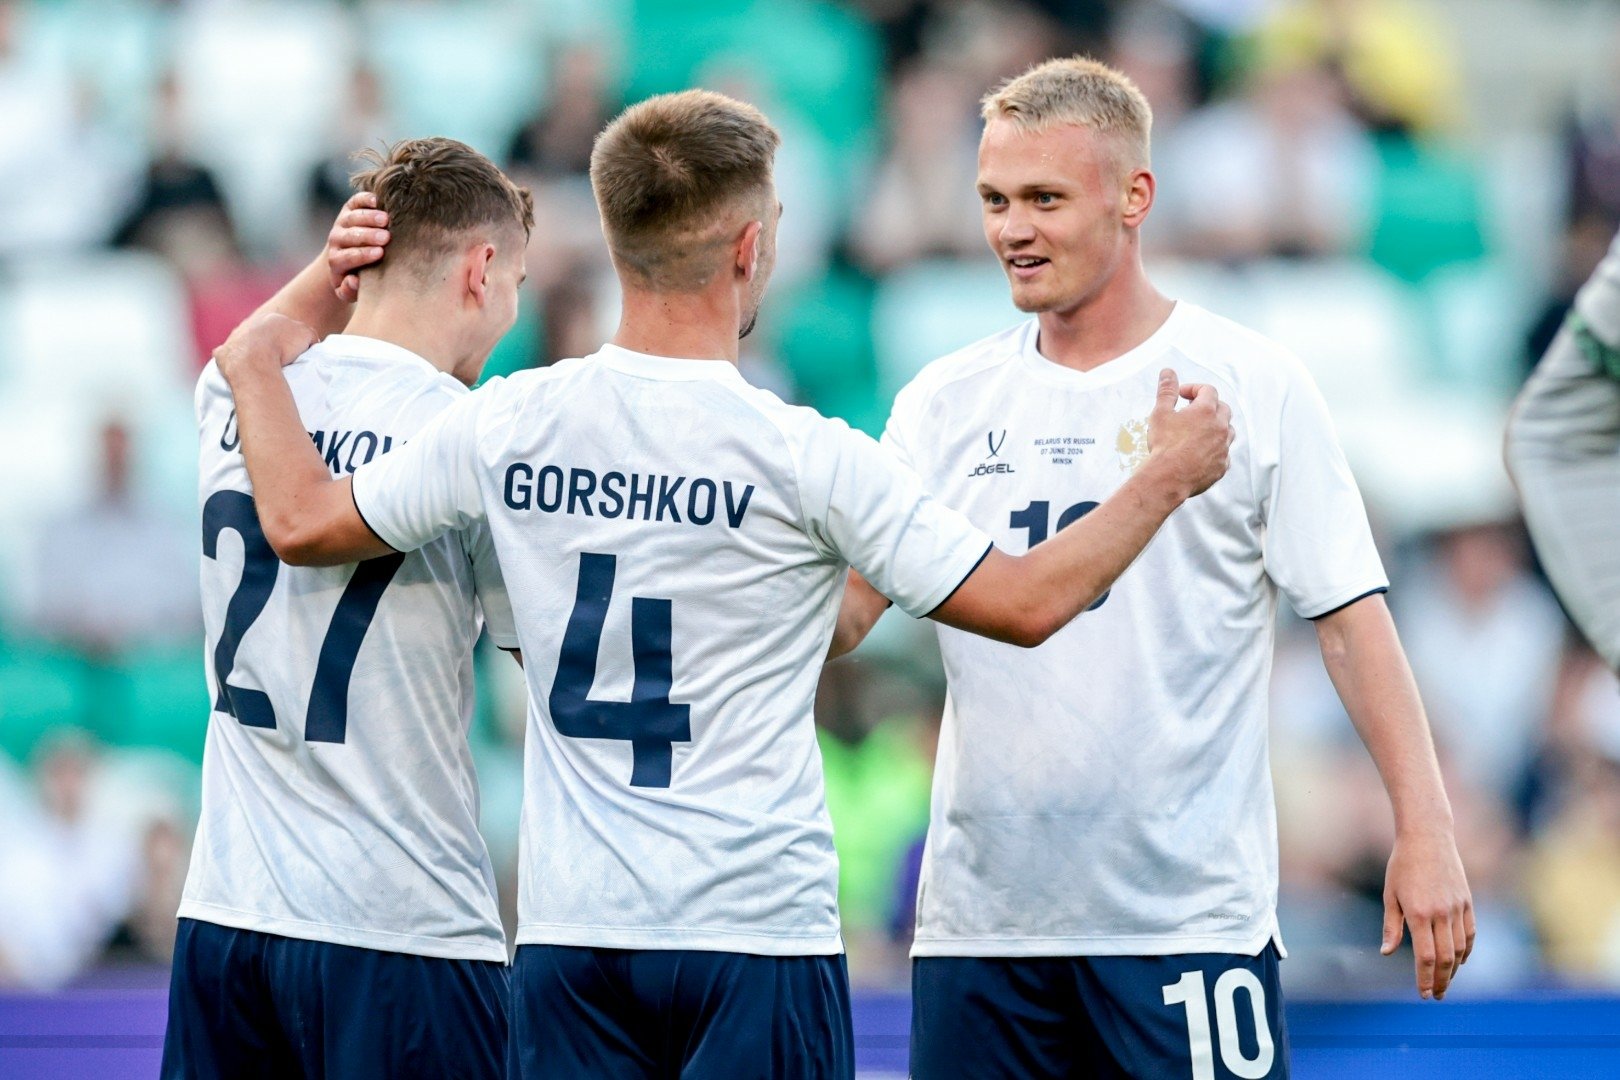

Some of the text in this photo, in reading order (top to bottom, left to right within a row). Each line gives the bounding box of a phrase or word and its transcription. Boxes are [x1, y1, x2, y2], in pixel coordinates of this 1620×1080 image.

[968, 463, 1015, 477] JÖGEL
[1034, 438, 1061, 446] BELARUS
[503, 462, 755, 529] GORSHKOV
[202, 489, 406, 744] 27
[549, 552, 691, 788] 4
[1162, 967, 1275, 1080] 10
